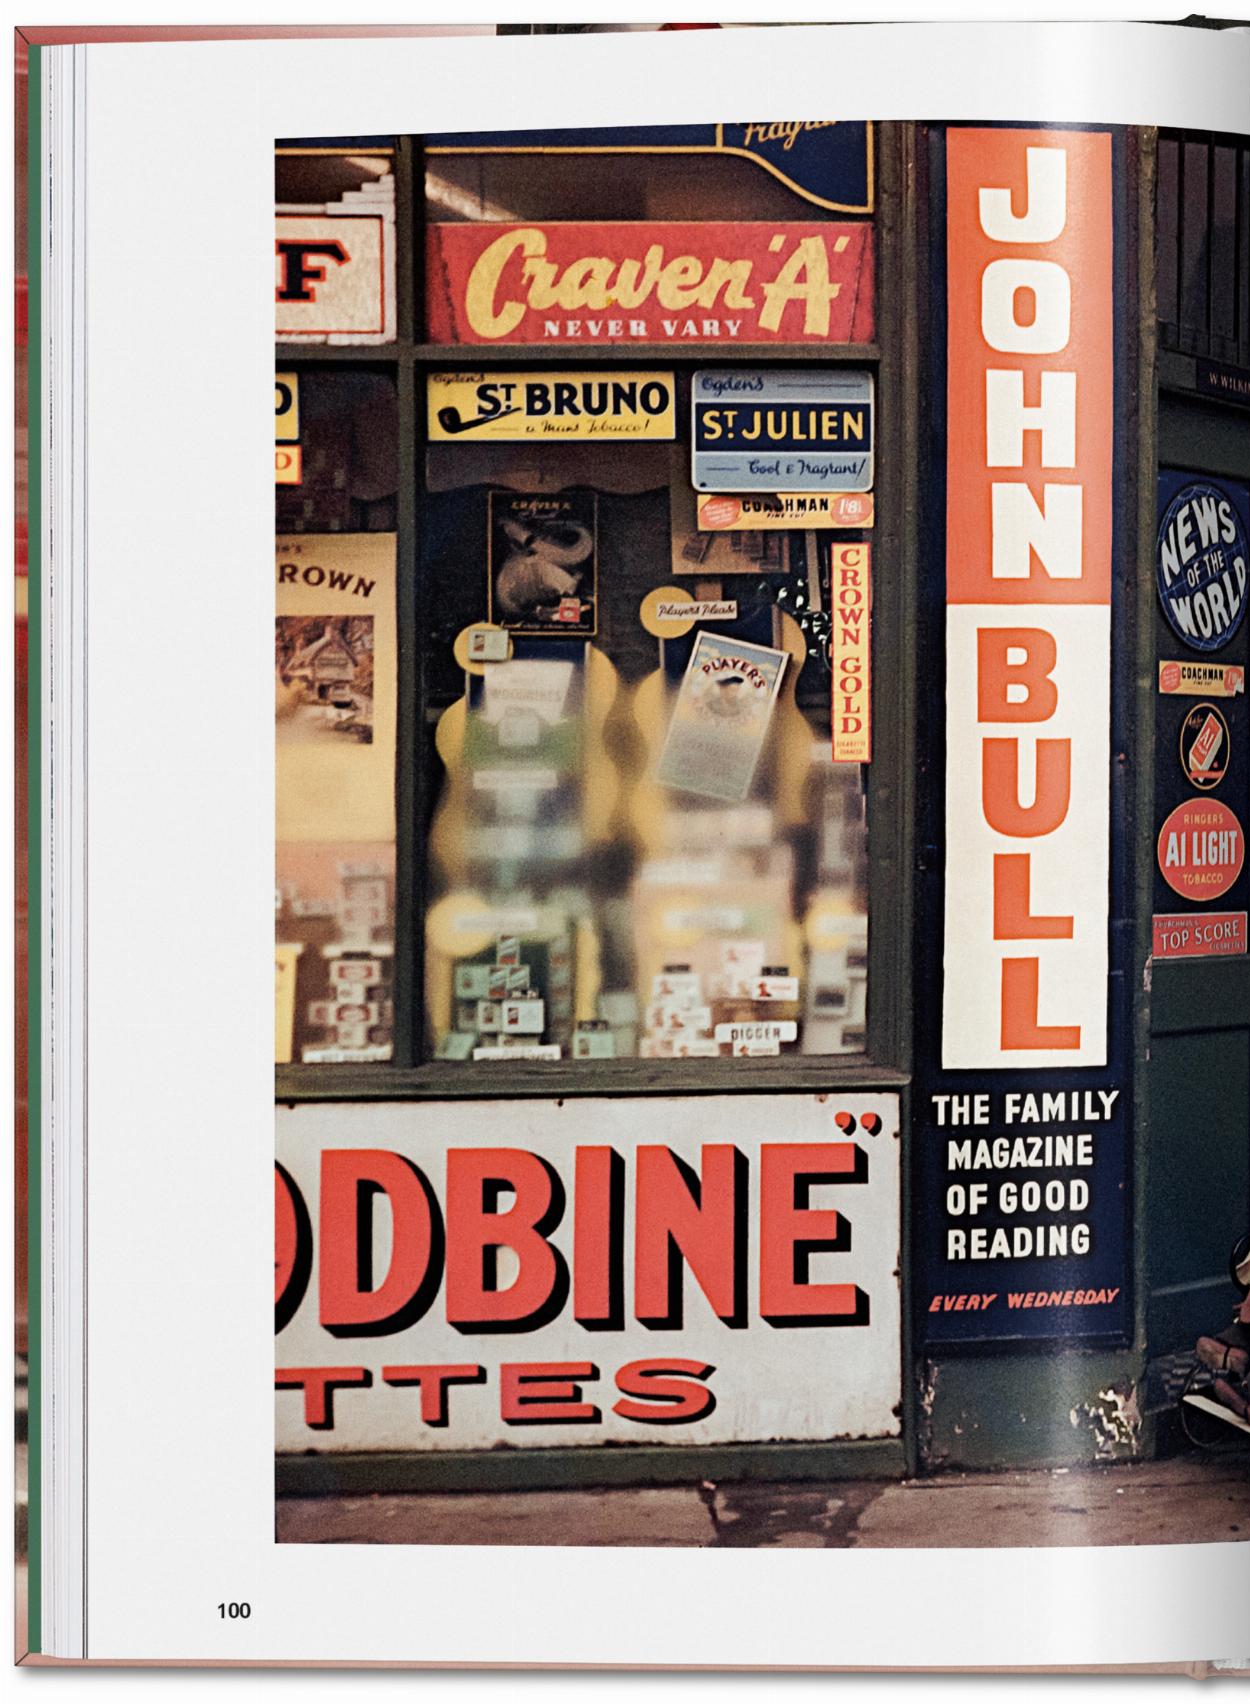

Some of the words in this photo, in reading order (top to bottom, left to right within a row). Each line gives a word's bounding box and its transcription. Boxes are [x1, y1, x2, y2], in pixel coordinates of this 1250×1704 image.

[466, 228, 756, 338] Craven
[544, 320, 647, 338] NEVER
[664, 320, 743, 338] VARY
[979, 147, 1083, 578] JOHN
[526, 381, 670, 416] BRUNO
[741, 410, 864, 440] JULIEN
[1161, 497, 1236, 587] NEWS
[278, 563, 376, 598] ROWN
[1187, 565, 1201, 588] OF
[1203, 550, 1225, 577] THE
[839, 549, 862, 646] CROWN
[1169, 556, 1247, 639] WORLD
[1181, 667, 1224, 681] COACHMAN
[839, 657, 862, 734] GOLD
[1183, 814, 1223, 825] RINGERS
[977, 627, 1081, 1051] BULL
[1192, 831, 1238, 866] LIGHT
[1183, 873, 1223, 886] TOBACCO
[1161, 930, 1189, 951] TOP
[1195, 920, 1240, 945] SCORE
[731, 1028, 781, 1040] DIGGER
[932, 1094, 990, 1126] THE
[1005, 1090, 1119, 1124] FAMILY
[948, 1134, 1093, 1171] MAGAZINE
[946, 1183, 988, 1216] OF
[999, 1178, 1090, 1214] GOOD
[947, 1223, 1090, 1260] READING
[929, 1294, 997, 1312] EVERY
[1007, 1288, 1120, 1309] WEDNESDAY
[218, 1602, 251, 1619] 100
